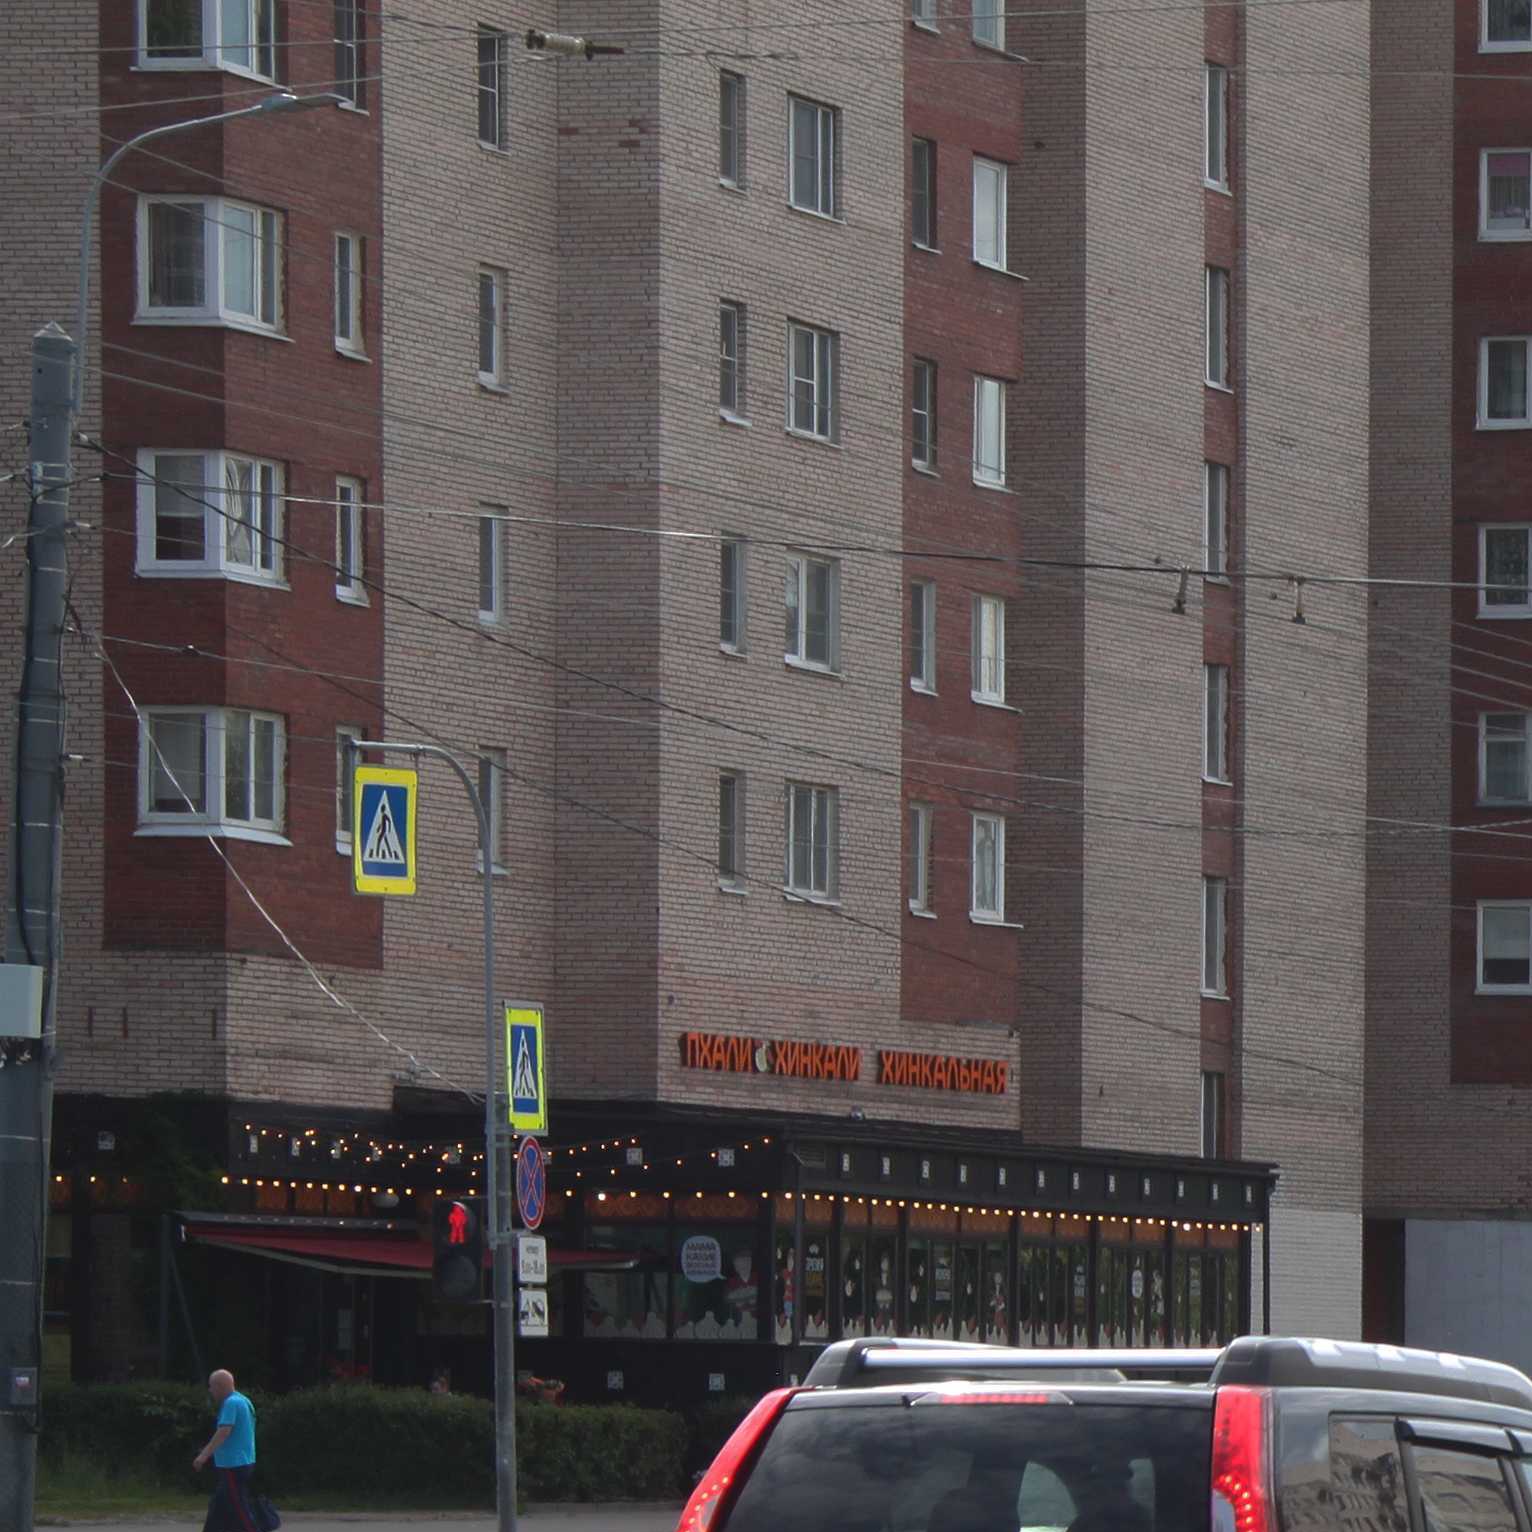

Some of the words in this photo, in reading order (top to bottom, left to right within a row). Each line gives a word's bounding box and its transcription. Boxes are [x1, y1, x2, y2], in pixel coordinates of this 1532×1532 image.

[684, 1031, 751, 1073] ПХАЛИ
[773, 1039, 861, 1082] ХИНКАЛИ
[880, 1050, 1009, 1094] ХИНКАЛЬНАЯ
